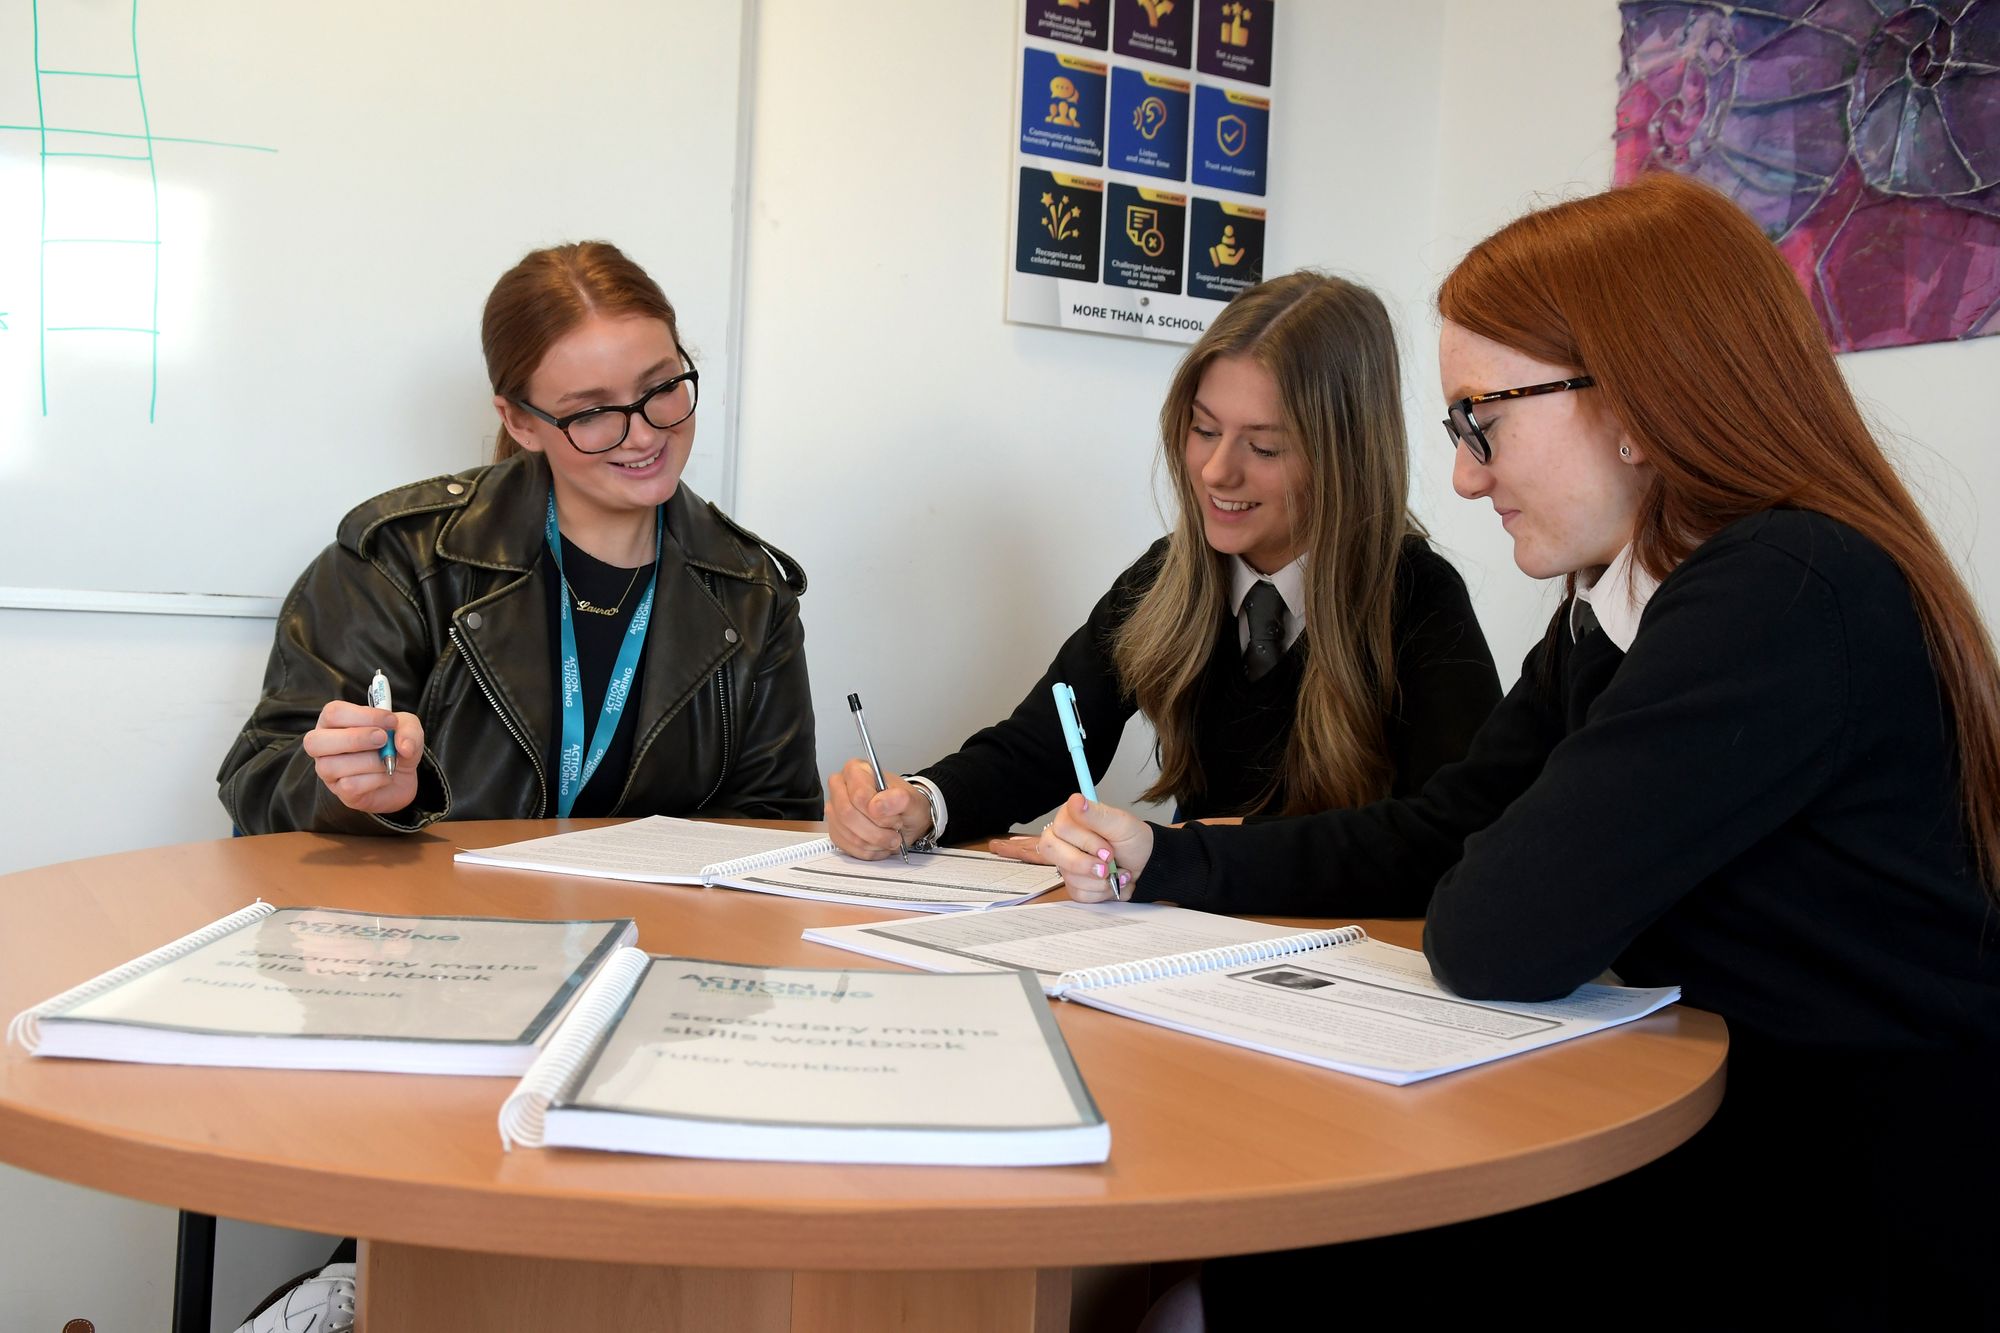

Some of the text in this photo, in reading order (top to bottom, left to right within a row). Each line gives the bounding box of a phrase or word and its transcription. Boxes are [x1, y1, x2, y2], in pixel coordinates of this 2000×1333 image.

[1084, 28, 1097, 38] and
[1022, 133, 1102, 157] honestly and consistently
[1028, 126, 1073, 143] Communicate
[1126, 154, 1170, 168] and make time
[1138, 148, 1158, 159] Listen
[1205, 160, 1256, 178] Trust and support
[1030, 256, 1086, 270] celebrate success
[1035, 247, 1082, 262] Recognise and
[1112, 259, 1176, 276] Challenge behaviours
[1139, 271, 1151, 281] line
[1151, 274, 1166, 282] with
[1195, 271, 1220, 283] Support
[1139, 280, 1159, 289] values
[1073, 304, 1205, 332] MORE THAN A SCHOOL
[577, 600, 618, 616] Laura
[630, 603, 644, 635] ACTION
[564, 660, 573, 708] TUTORING
[569, 656, 579, 693] ACTION
[605, 679, 620, 714] ACTION
[613, 667, 633, 712] TUTORING
[561, 749, 571, 796] TUTORING
[570, 743, 580, 781] ACTION
[285, 920, 414, 934] ACTION
[216, 960, 493, 982] skills workbook
[237, 950, 539, 971] Secondary maths
[182, 976, 404, 998] Pupil workbook
[679, 974, 815, 990] ACTION
[670, 1012, 998, 1037] Secondary maths
[663, 1026, 965, 1051] skills workbook
[655, 1051, 898, 1074] Tutor workbook
